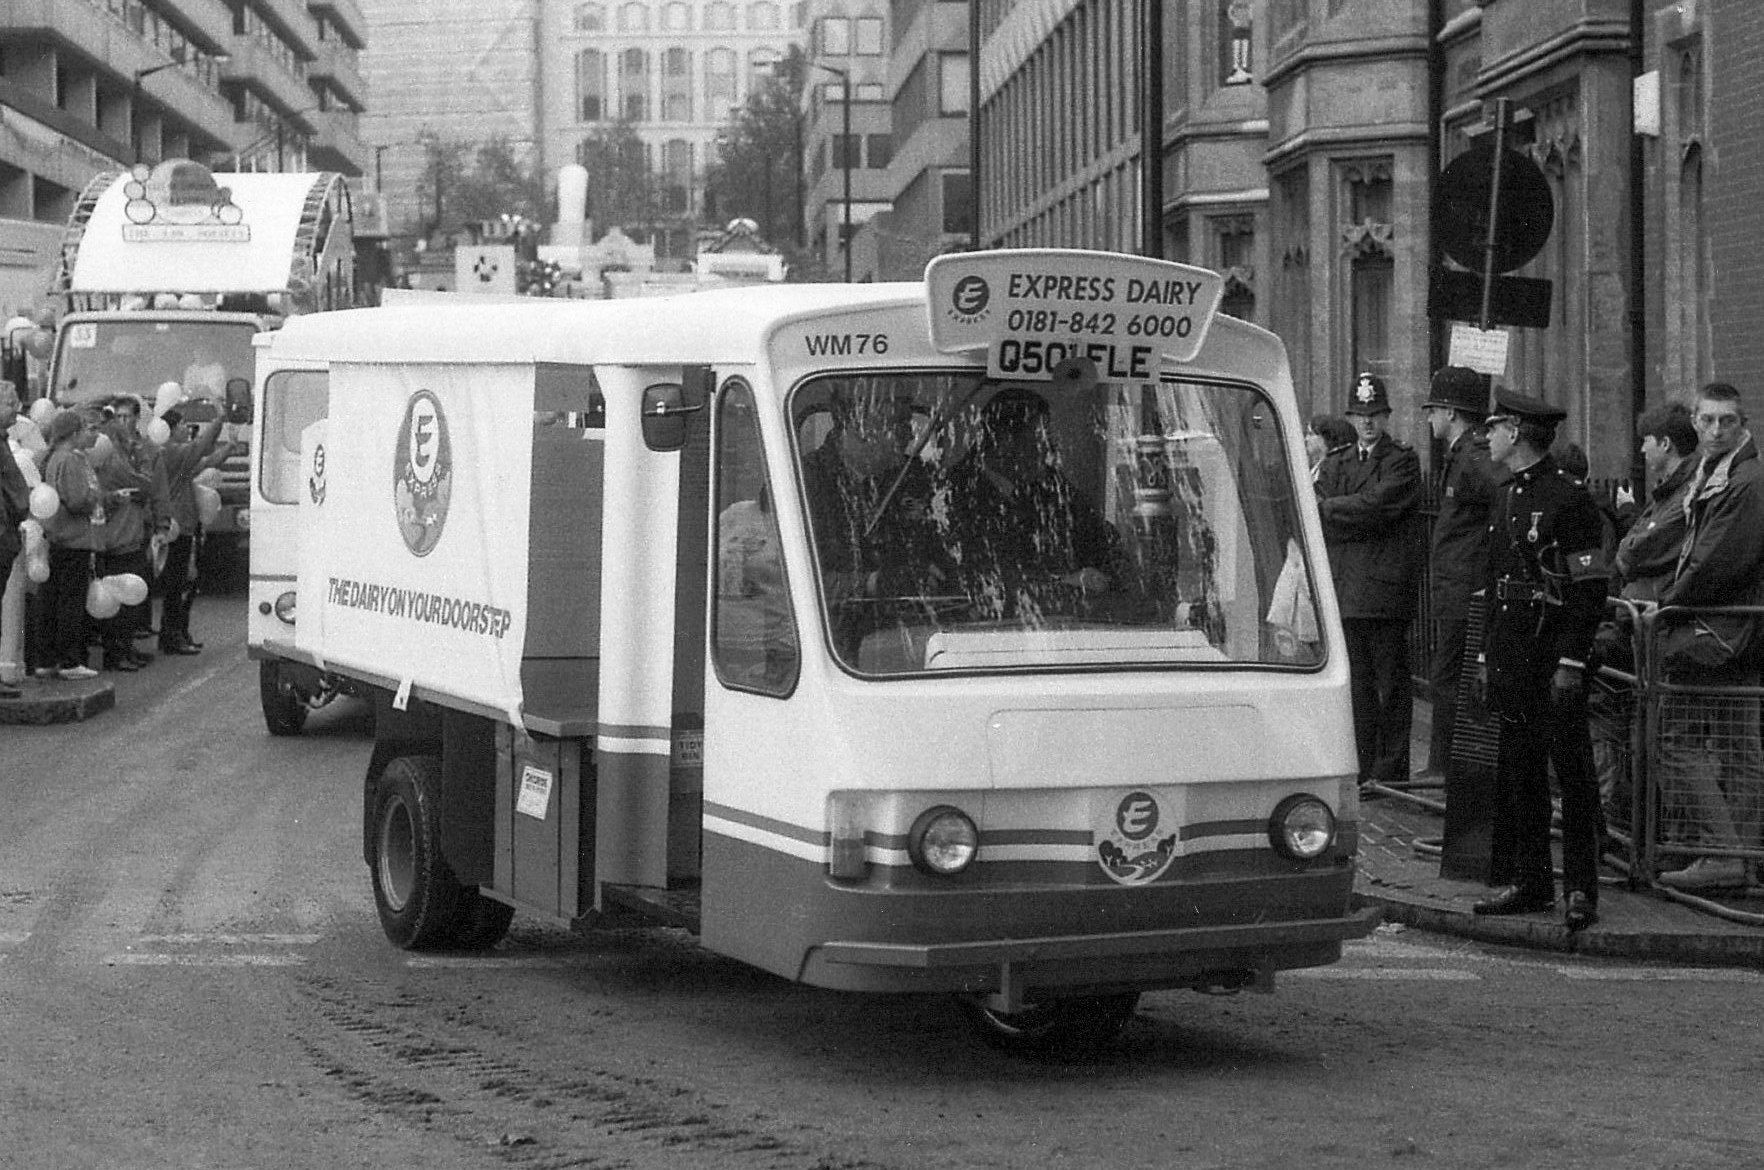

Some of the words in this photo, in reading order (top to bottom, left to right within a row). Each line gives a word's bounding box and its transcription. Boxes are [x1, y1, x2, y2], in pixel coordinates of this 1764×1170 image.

[1008, 274, 1115, 302] EXPRESS
[1126, 278, 1202, 305] DAIRY
[1008, 310, 1116, 335] 0181-842
[1127, 314, 1192, 338] 6000
[1086, 343, 1152, 378] FLE
[328, 577, 350, 606] THE
[350, 581, 388, 613] DAIRY
[388, 587, 407, 618] ON
[407, 590, 441, 625] YOUR
[441, 597, 511, 639] DOORSTEP
